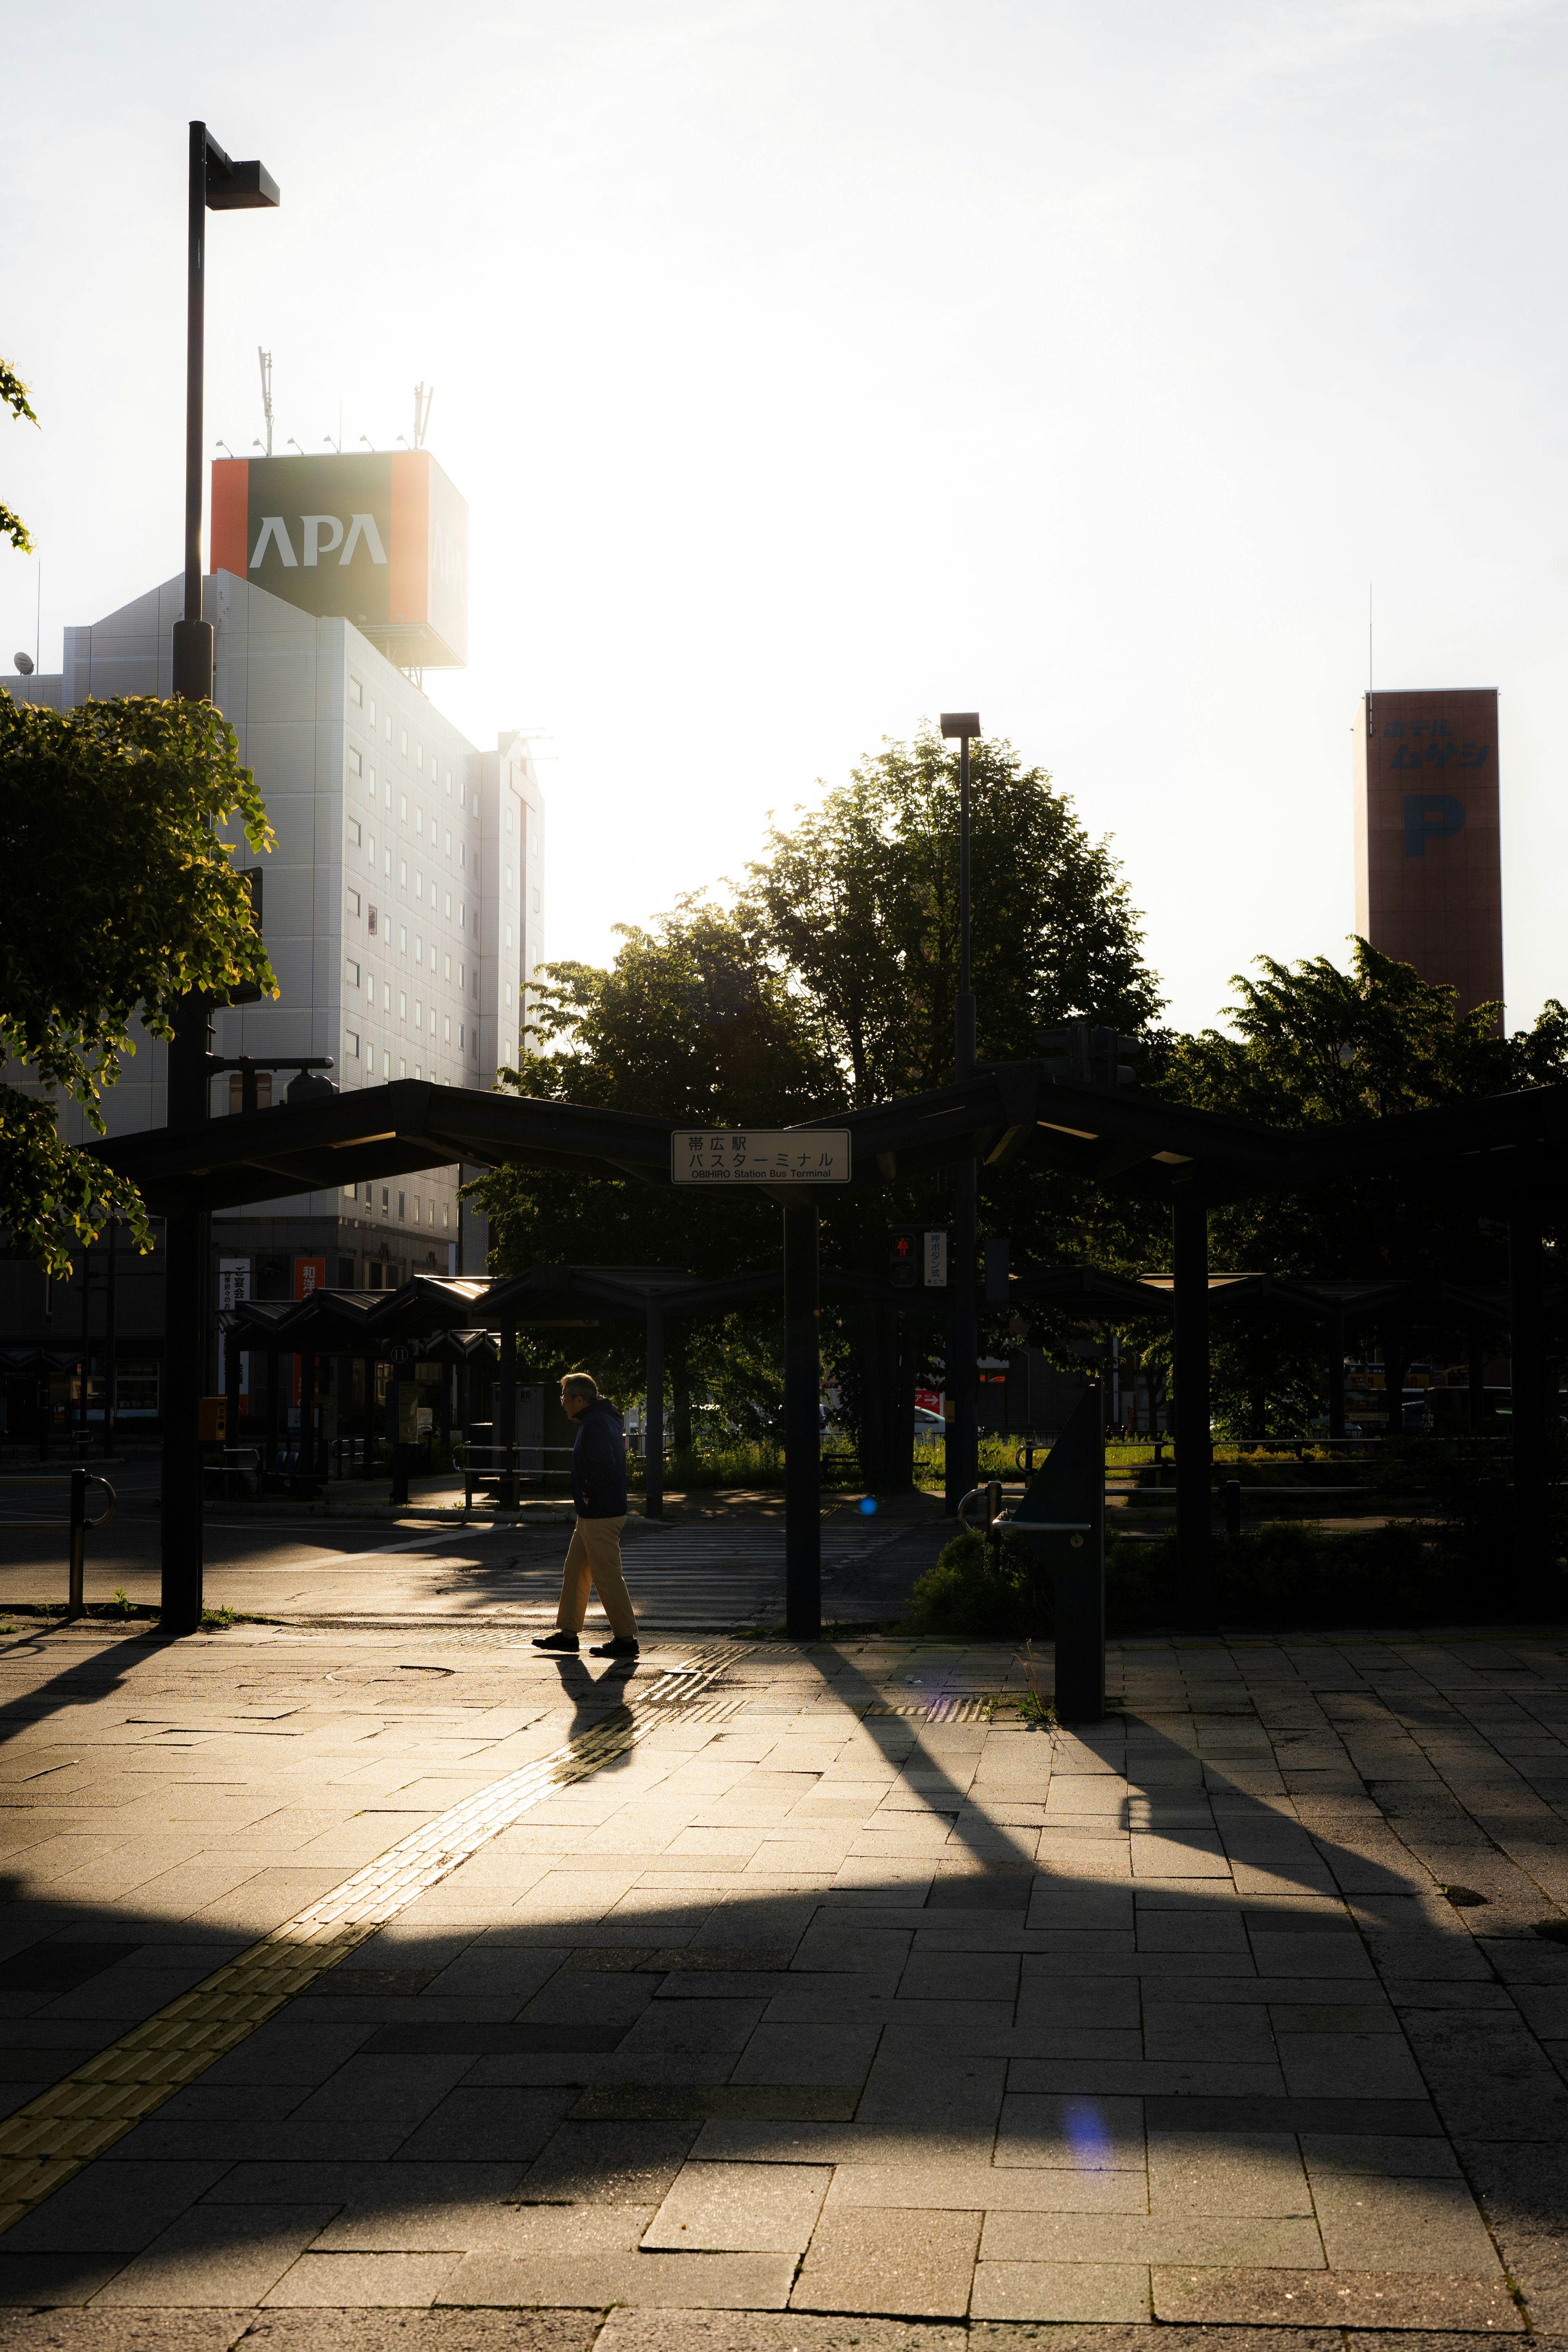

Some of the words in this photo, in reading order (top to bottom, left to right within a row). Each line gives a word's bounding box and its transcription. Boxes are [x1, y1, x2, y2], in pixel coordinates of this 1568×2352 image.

[249, 514, 388, 568] APA
[1383, 719, 1453, 738] ホテル
[1390, 742, 1490, 768] ムサシ
[1403, 795, 1466, 858] P
[689, 1136, 746, 1151] 帯広駅
[689, 1153, 833, 1168] バスターミナル
[692, 1170, 731, 1178] OBIHIRO
[734, 1169, 766, 1178] Station
[770, 1169, 786, 1178] Bus
[791, 1169, 831, 1178] Terminal
[931, 1235, 940, 1277] 押ボタン式
